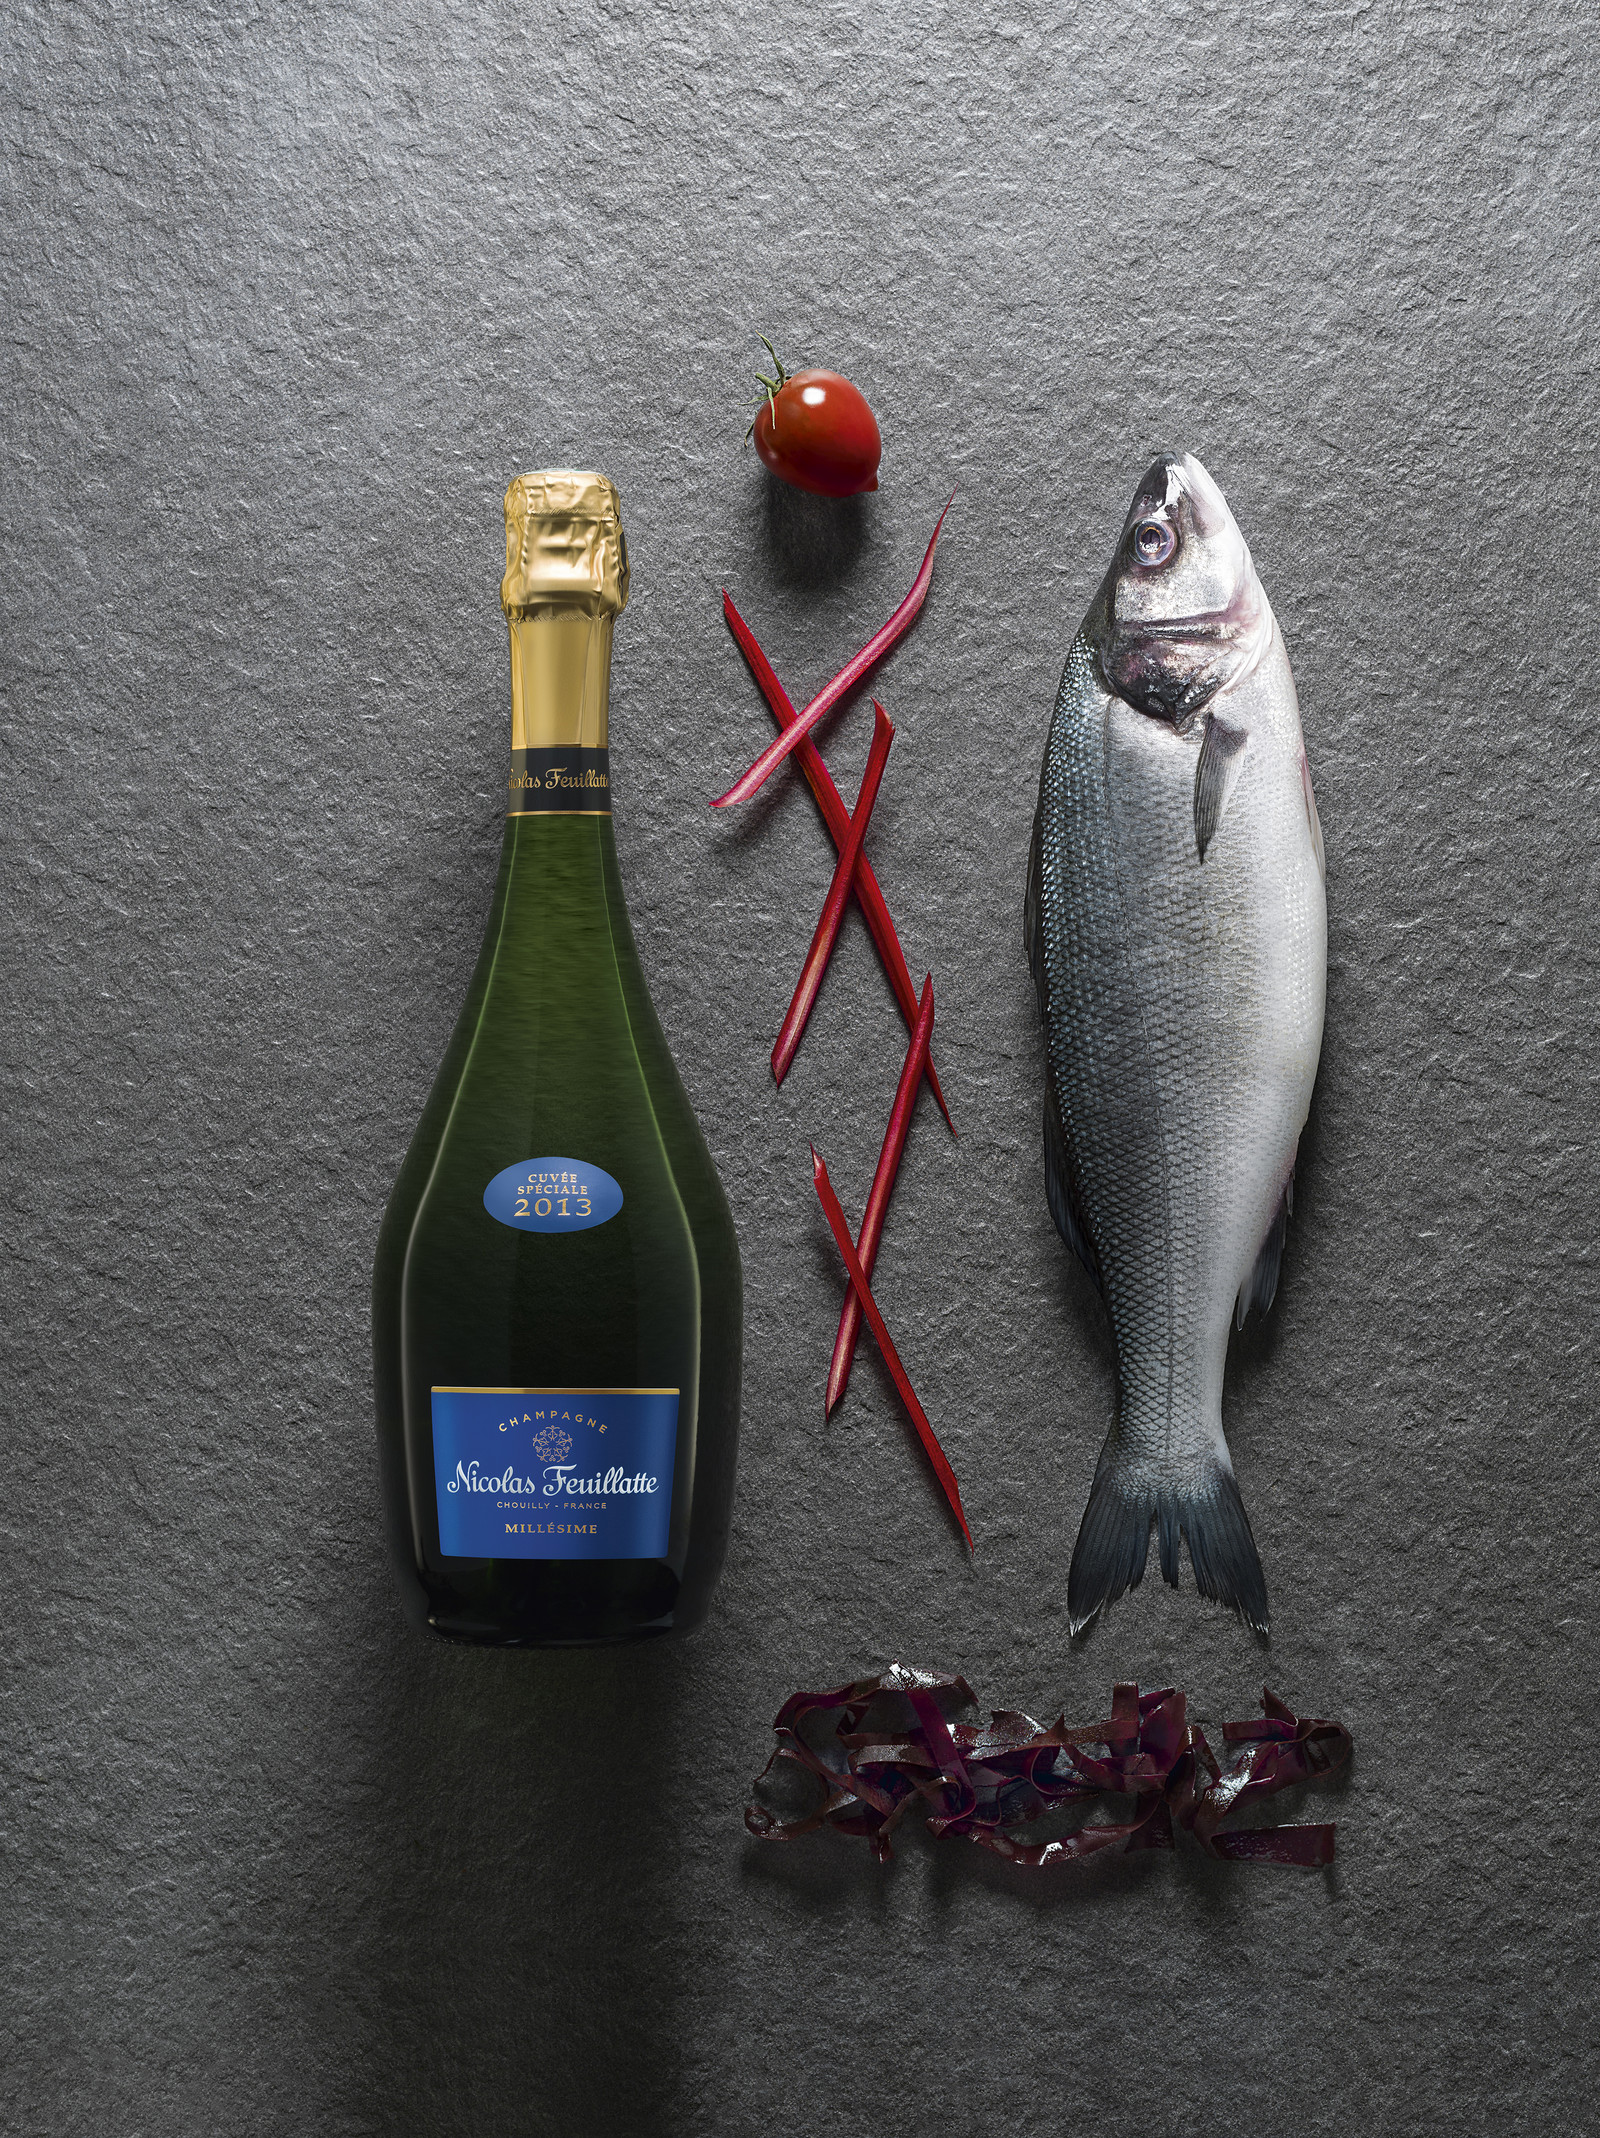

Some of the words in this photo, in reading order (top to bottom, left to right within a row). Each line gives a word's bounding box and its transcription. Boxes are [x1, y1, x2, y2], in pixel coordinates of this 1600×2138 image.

[528, 1171, 578, 1183] CUVÉE
[517, 1183, 588, 1195] SPÉCIALE
[513, 1198, 592, 1217] 2013
[498, 1410, 608, 1434] CHAMPAGNE
[447, 1460, 536, 1494] Nicolas
[542, 1463, 660, 1497] Feuillatte
[496, 1501, 551, 1510] CHOUILLY
[563, 1502, 607, 1510] FRANCE
[504, 1522, 598, 1534] MILLÉSIME
